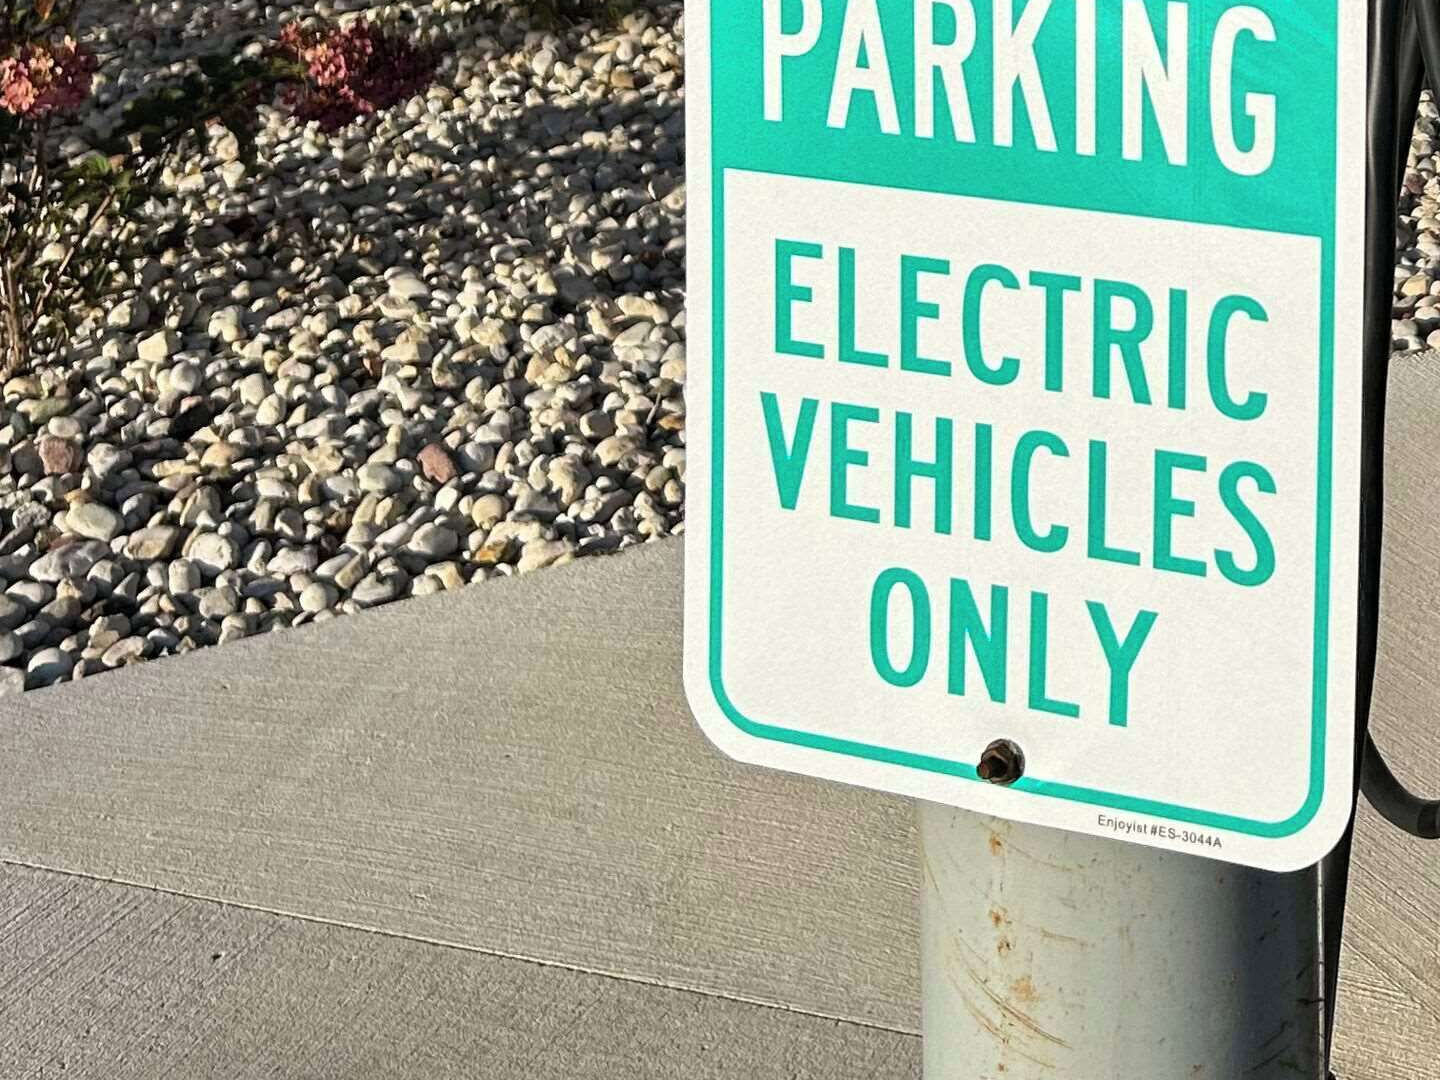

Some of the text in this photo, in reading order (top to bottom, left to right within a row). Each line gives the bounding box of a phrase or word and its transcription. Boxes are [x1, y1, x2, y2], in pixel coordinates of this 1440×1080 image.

[774, 239, 1268, 421] ELECTRIC
[761, 392, 1277, 587] VEHICLES
[869, 567, 1158, 728] ONLY
[1098, 814, 1222, 848] Enjoyist #ES-3044A
